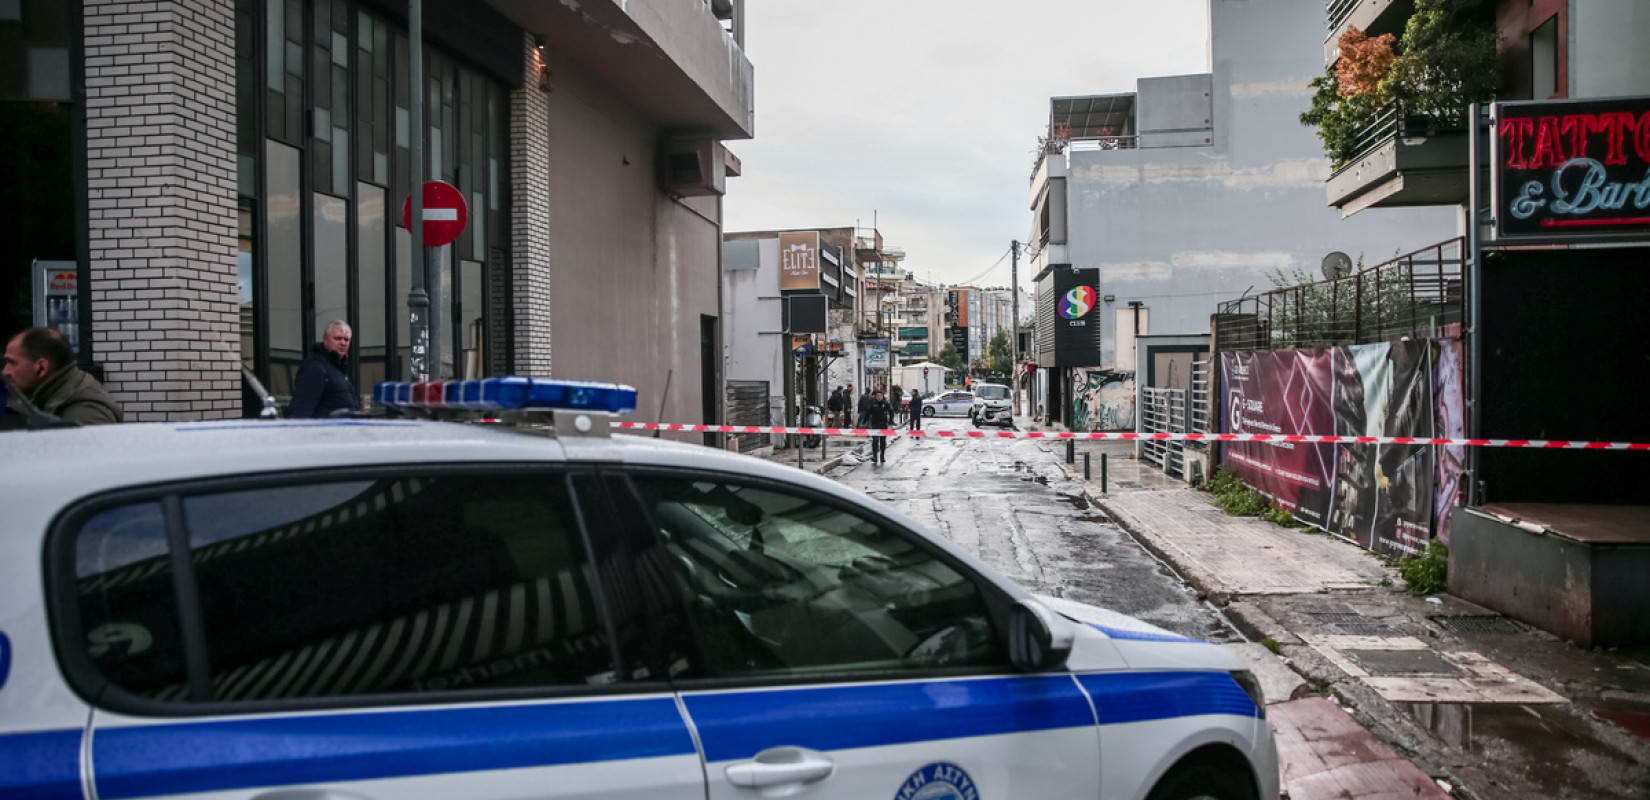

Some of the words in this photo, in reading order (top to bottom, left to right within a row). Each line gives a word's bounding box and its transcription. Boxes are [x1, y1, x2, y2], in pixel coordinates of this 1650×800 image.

[1510, 180, 1546, 219] &
[783, 248, 815, 270] ELITE
[1065, 289, 1089, 316] S
[1231, 396, 1240, 430] G
